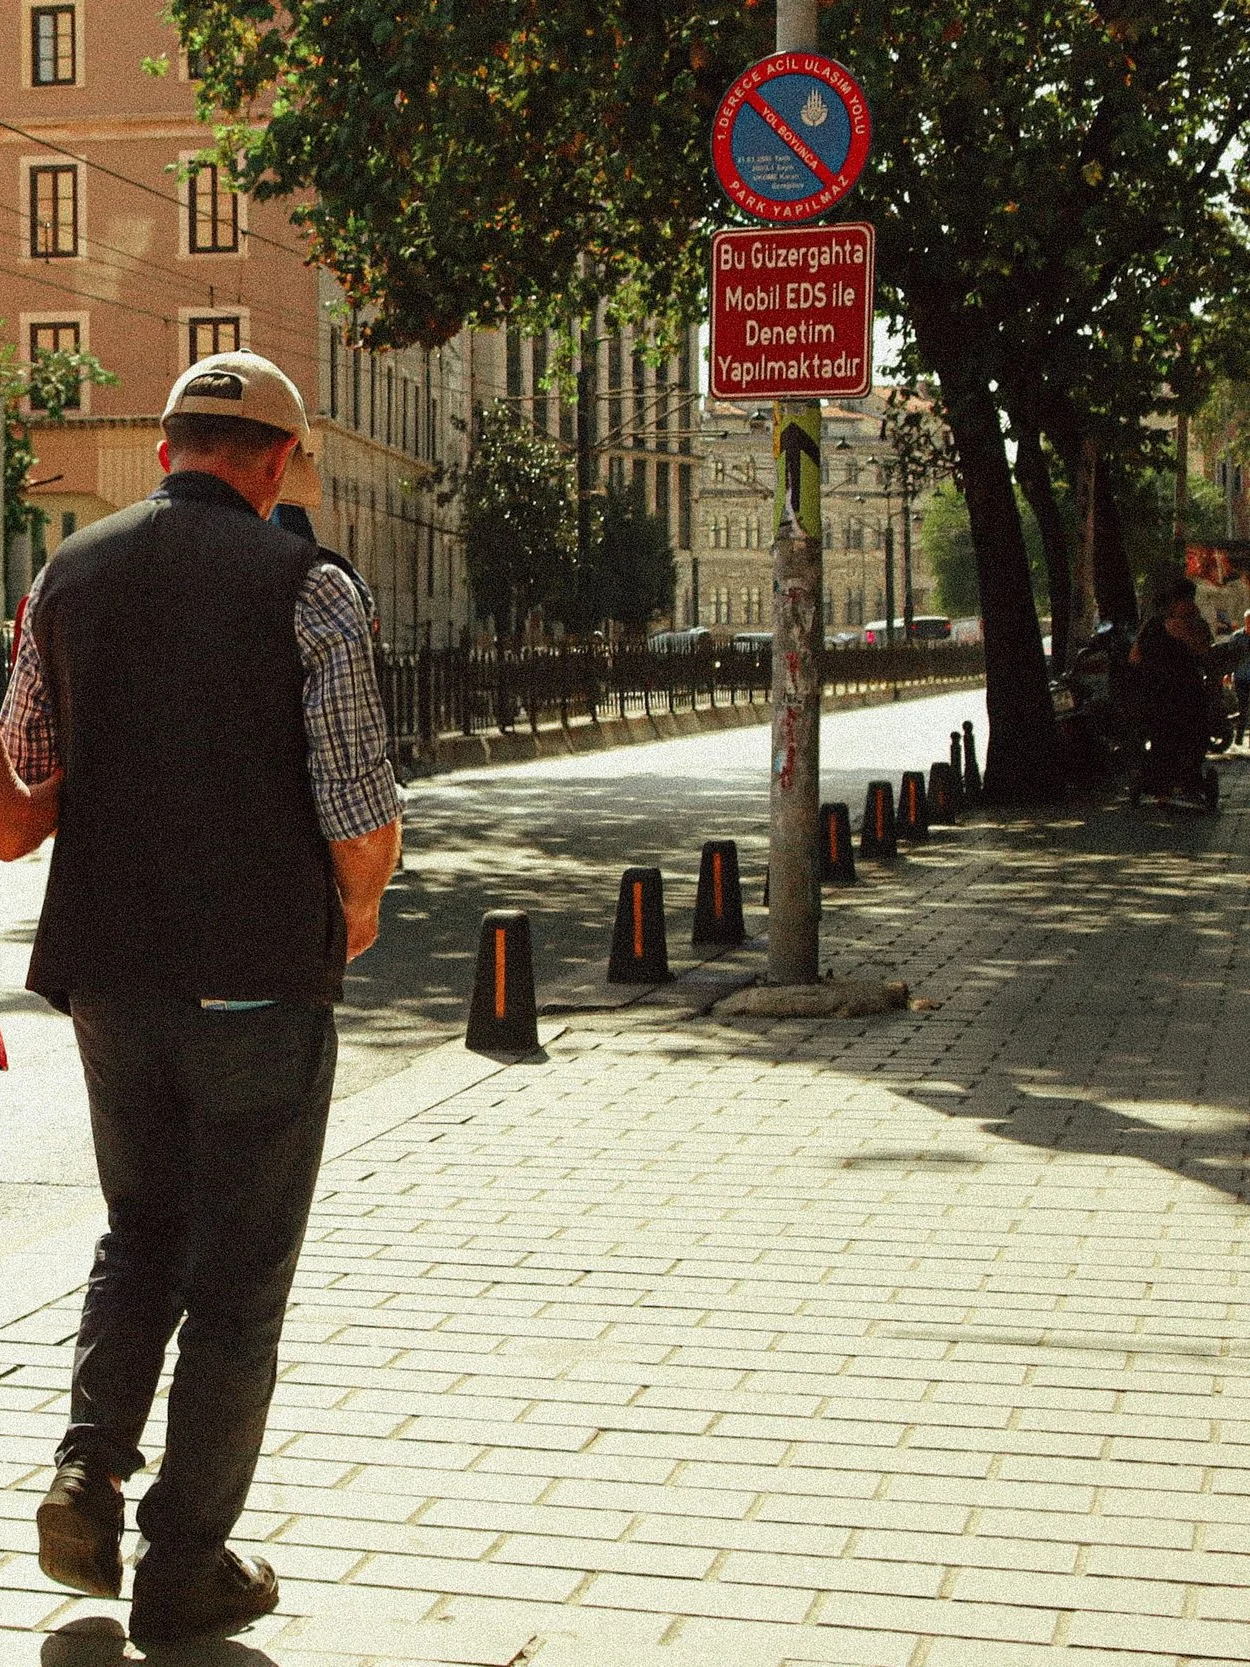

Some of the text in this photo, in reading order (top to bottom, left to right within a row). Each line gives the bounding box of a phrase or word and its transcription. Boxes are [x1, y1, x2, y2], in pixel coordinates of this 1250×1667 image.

[766, 58, 799, 75] ACİL
[804, 59, 852, 95] ULAŞIM
[849, 95, 867, 135] YOLU
[761, 107, 818, 169] YOL BOYUNCA
[730, 176, 849, 217] PARK YAPILMAZ
[720, 238, 864, 273] Bu Güzergahta
[725, 281, 856, 312] Mobil EDS ile
[746, 319, 835, 346] Denetim
[717, 351, 861, 388] Yapılmaktadır
